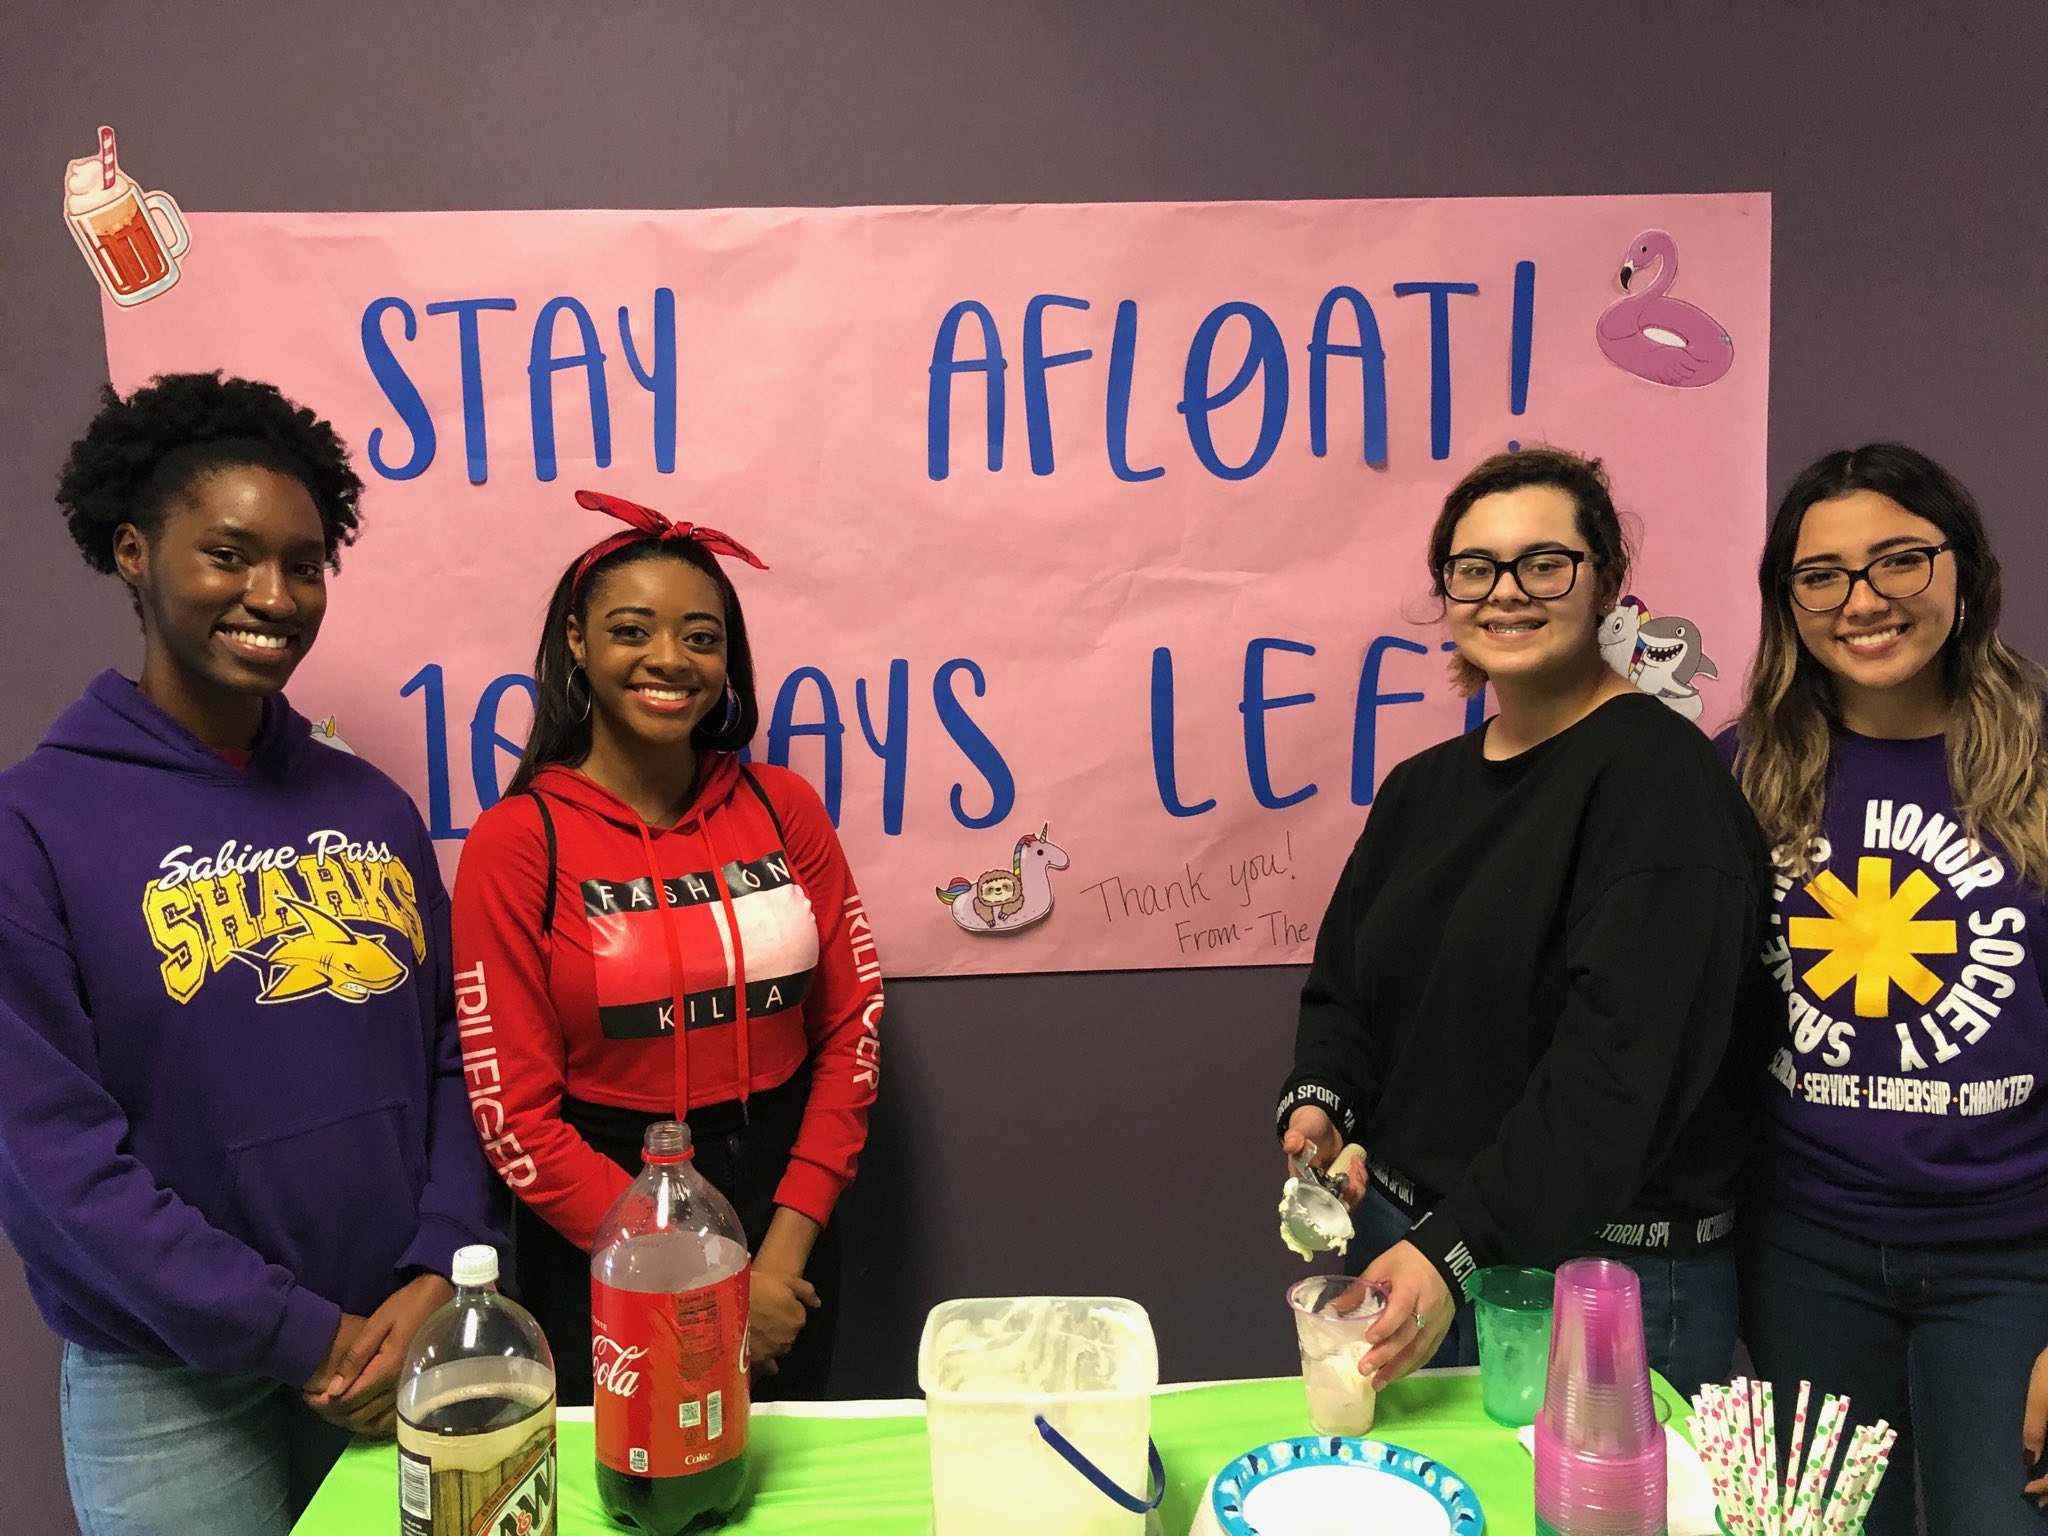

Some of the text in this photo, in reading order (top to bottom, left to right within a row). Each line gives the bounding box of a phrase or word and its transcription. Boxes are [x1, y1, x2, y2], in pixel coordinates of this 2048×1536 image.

[361, 260, 1536, 485] STAY AFLOAT!
[400, 663, 541, 840] 10
[742, 657, 1014, 835] AYS
[158, 829, 394, 891] Sabine Pass
[1080, 831, 1297, 922] Thank you!
[1863, 799, 2005, 900] HONOR
[599, 857, 791, 910] FASHON
[142, 853, 427, 1005] SHARKS
[658, 985, 783, 1030] KILA
[1895, 906, 2027, 1073] SOCIETY
[1297, 1084, 1341, 1112] SPORT
[1803, 1072, 1861, 1108] SERVICE
[1868, 1075, 1952, 1116] LEADERSHIP
[632, 1449, 646, 1459] 140
[684, 1451, 711, 1466] Coke
